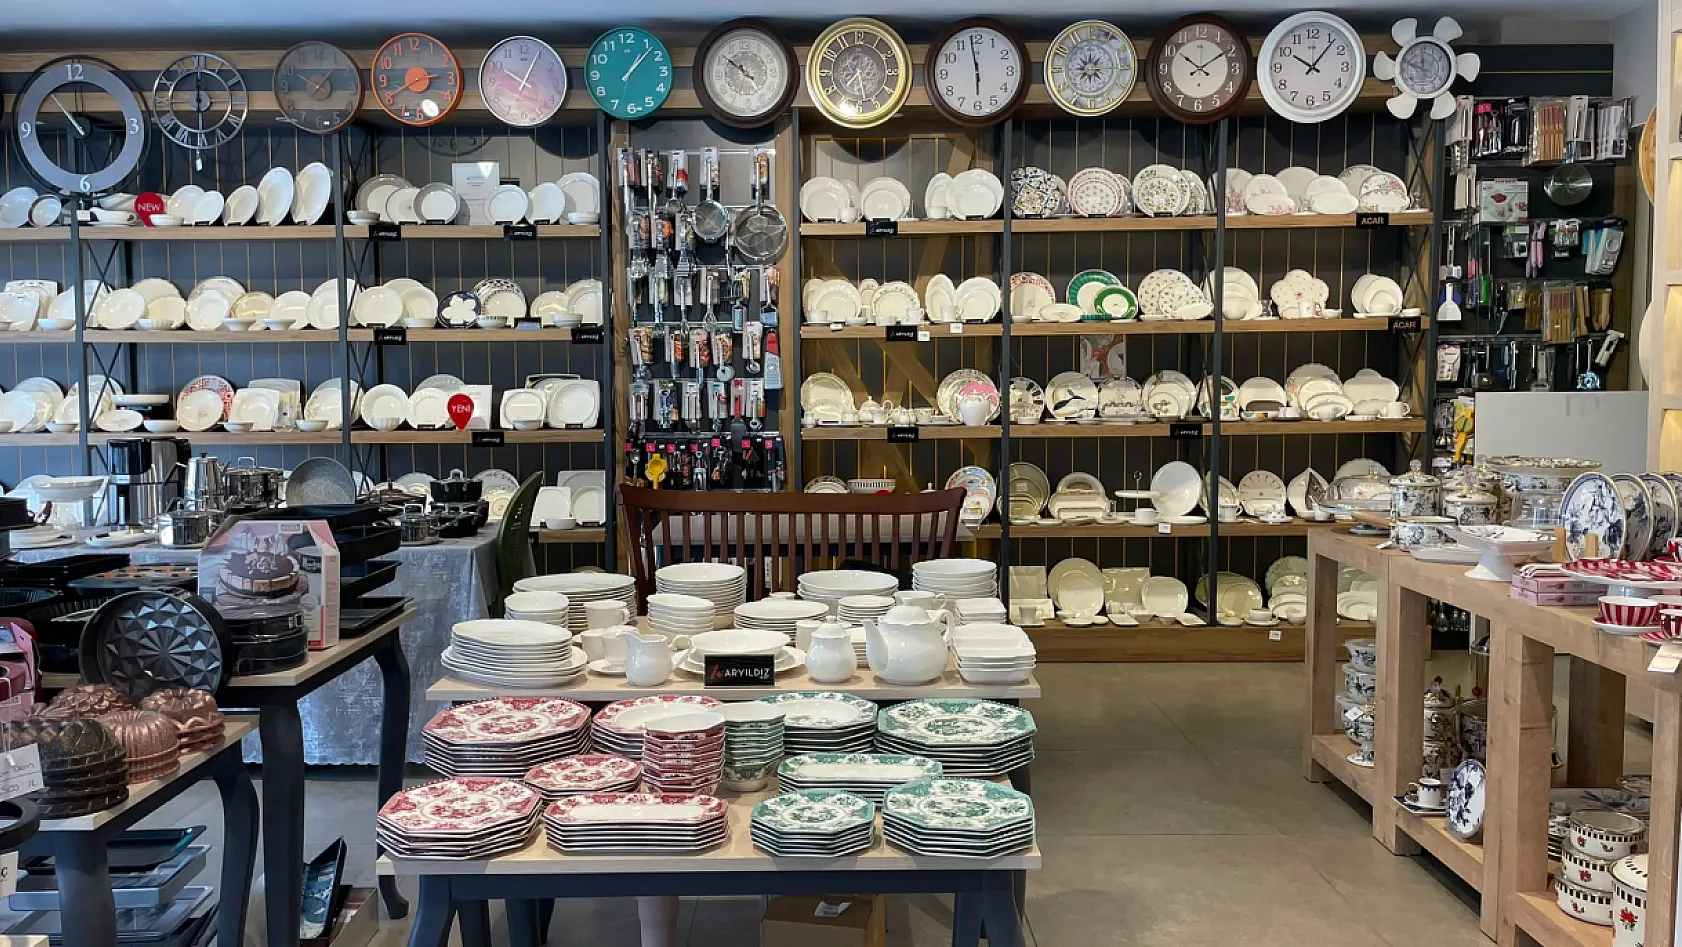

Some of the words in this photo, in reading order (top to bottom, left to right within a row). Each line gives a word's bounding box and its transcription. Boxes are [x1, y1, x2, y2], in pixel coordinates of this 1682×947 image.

[619, 32, 635, 44] 12
[1178, 31, 1187, 44] 11
[1195, 26, 1208, 38] 12
[1215, 31, 1221, 44] 1
[1306, 29, 1320, 39] 12
[1327, 33, 1331, 43] 1
[408, 37, 420, 51] 12
[643, 38, 649, 49] 1
[955, 40, 965, 51] 11
[989, 38, 995, 48] 1
[1292, 34, 1302, 45] 11
[393, 42, 403, 56] 11
[428, 42, 434, 55] 1
[602, 40, 615, 52] 11
[1165, 44, 1176, 57] 10
[1227, 44, 1236, 57] 2
[1279, 47, 1292, 57] 10
[1336, 45, 1346, 56] 2
[592, 53, 608, 65] 10
[654, 50, 663, 62] 2
[943, 52, 957, 64] 10
[1000, 49, 1009, 60] 2
[381, 56, 392, 70] 10
[441, 55, 449, 67] 2
[1341, 61, 1350, 72] 3
[65, 64, 84, 80] 12
[659, 65, 668, 77] 3
[1006, 65, 1015, 77] 3
[1160, 63, 1168, 75] 9
[1231, 62, 1240, 75] 3
[1273, 62, 1282, 73] 9
[446, 71, 454, 85] 3
[590, 69, 600, 81] 9
[940, 68, 948, 80] 9
[379, 74, 388, 88] 9
[1163, 81, 1172, 93] 8
[1225, 81, 1233, 93] 4
[1278, 79, 1287, 90] 8
[1334, 77, 1342, 88] 4
[596, 86, 606, 96] 8
[655, 82, 666, 94] 4
[946, 85, 954, 96] 8
[1000, 82, 1008, 93] 4
[385, 92, 394, 105] 8
[444, 90, 452, 102] 4
[644, 96, 654, 107] 5
[958, 96, 966, 107] 7
[989, 95, 998, 106] 5
[1177, 95, 1184, 107] 7
[1212, 94, 1220, 107] 5
[1290, 91, 1299, 101] 7
[1306, 95, 1315, 106] 6
[1322, 91, 1331, 101] 5
[610, 99, 619, 110] 7
[973, 101, 982, 111] 6
[1194, 99, 1202, 111] 6
[415, 107, 424, 121] 6
[20, 122, 32, 138] 9
[129, 118, 140, 135] 3
[80, 175, 91, 192] 6
[137, 202, 160, 212] NEW
[1361, 216, 1385, 225] ACAR
[1392, 321, 1416, 330] ACAR
[724, 667, 770, 677] ARYILDIZ
